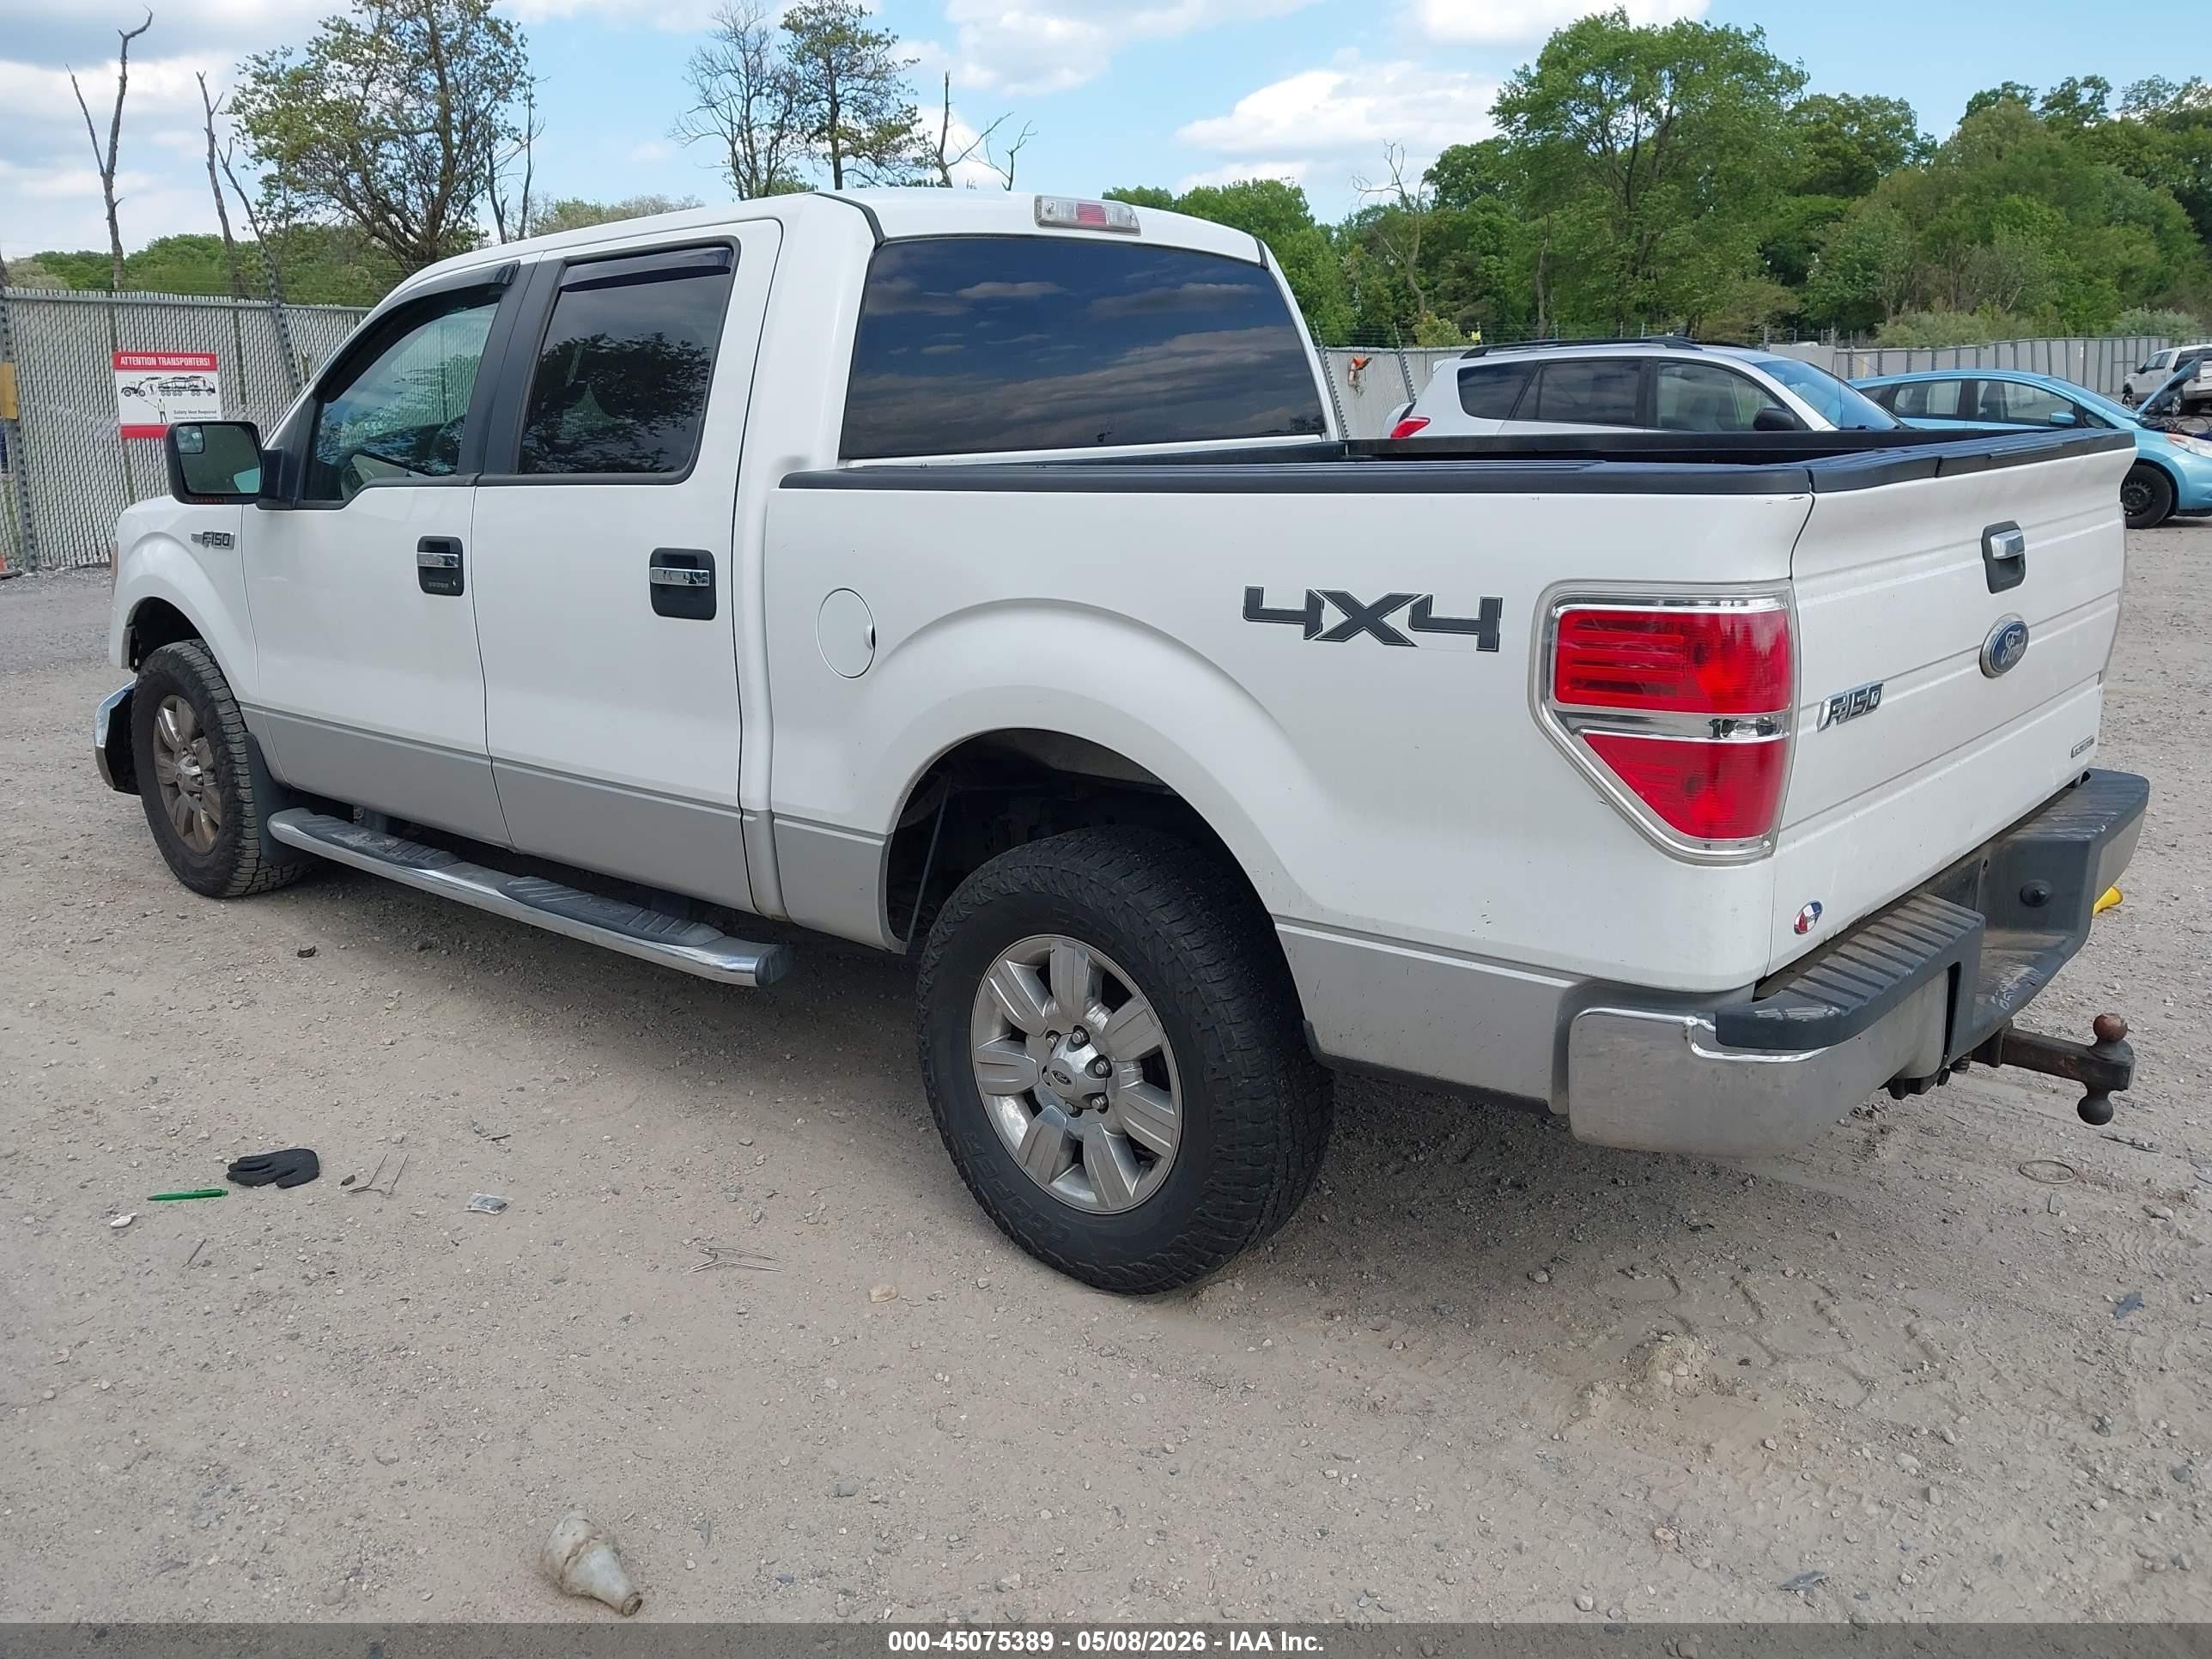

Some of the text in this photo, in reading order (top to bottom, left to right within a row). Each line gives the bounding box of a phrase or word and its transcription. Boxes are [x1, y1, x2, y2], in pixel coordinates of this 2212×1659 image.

[120, 356, 210, 367] ATTENTION TRANSPORTERS!
[1243, 586, 1503, 653] 4X4
